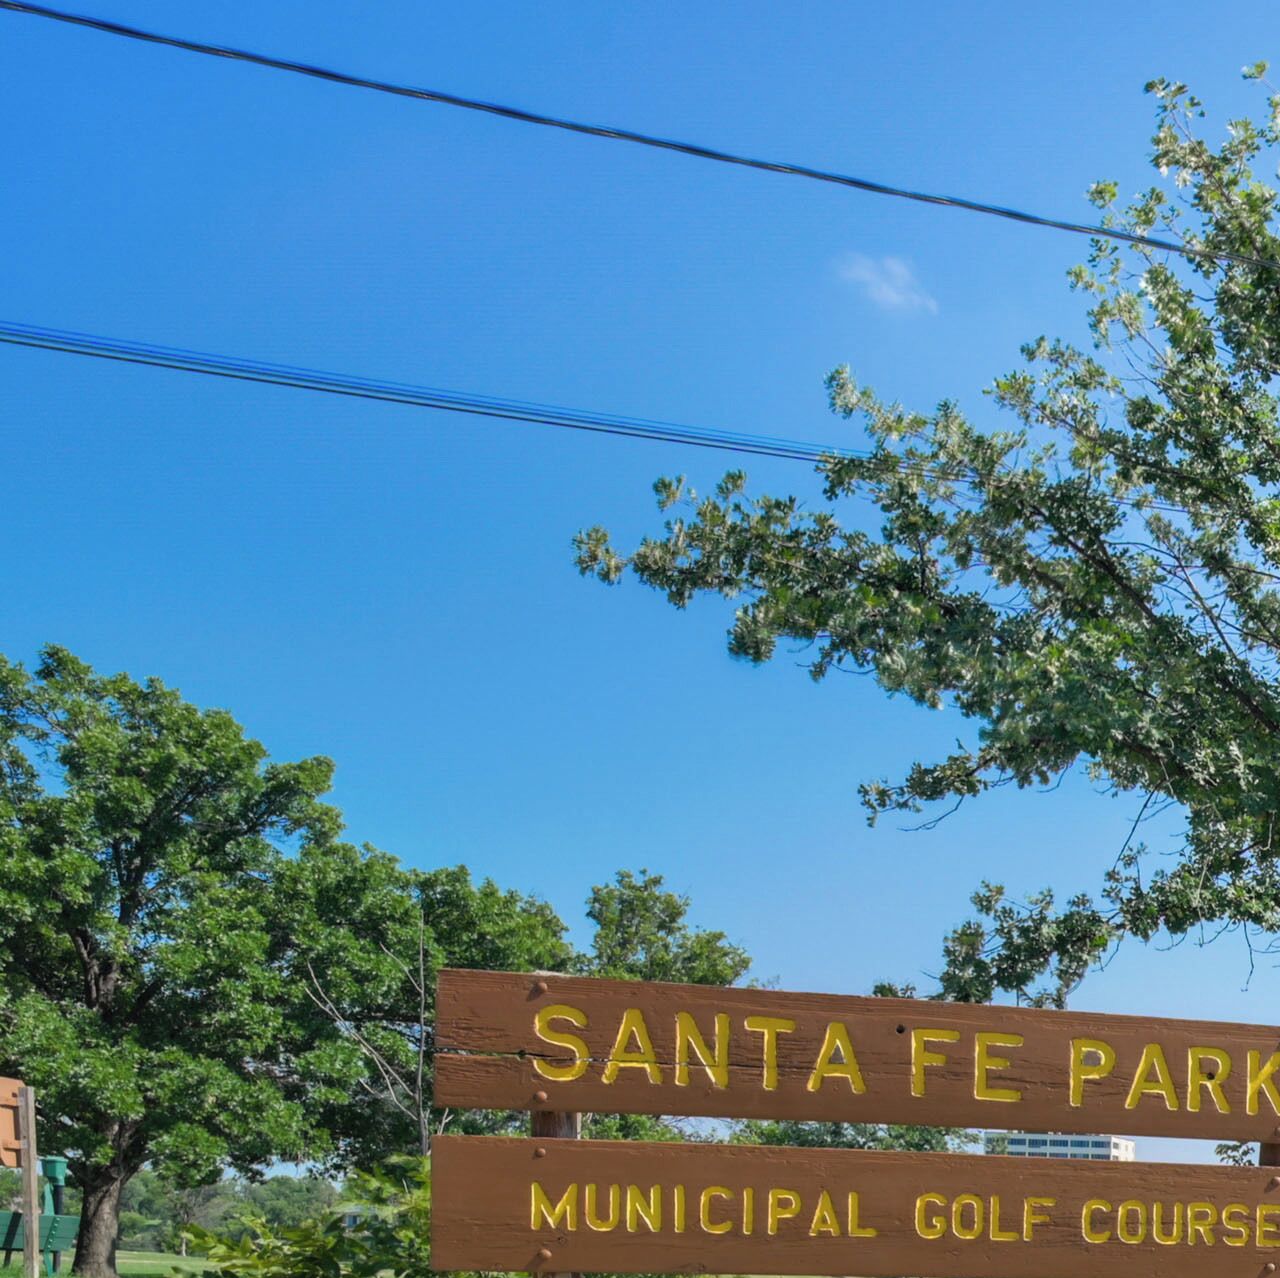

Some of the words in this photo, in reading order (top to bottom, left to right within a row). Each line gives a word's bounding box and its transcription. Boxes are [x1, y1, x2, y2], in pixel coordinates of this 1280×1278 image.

[531, 1003, 868, 1095] SANTA
[910, 1028, 1025, 1104] FE
[529, 1180, 879, 1240] MUNICIPAL
[914, 1191, 1058, 1244] GOLF
